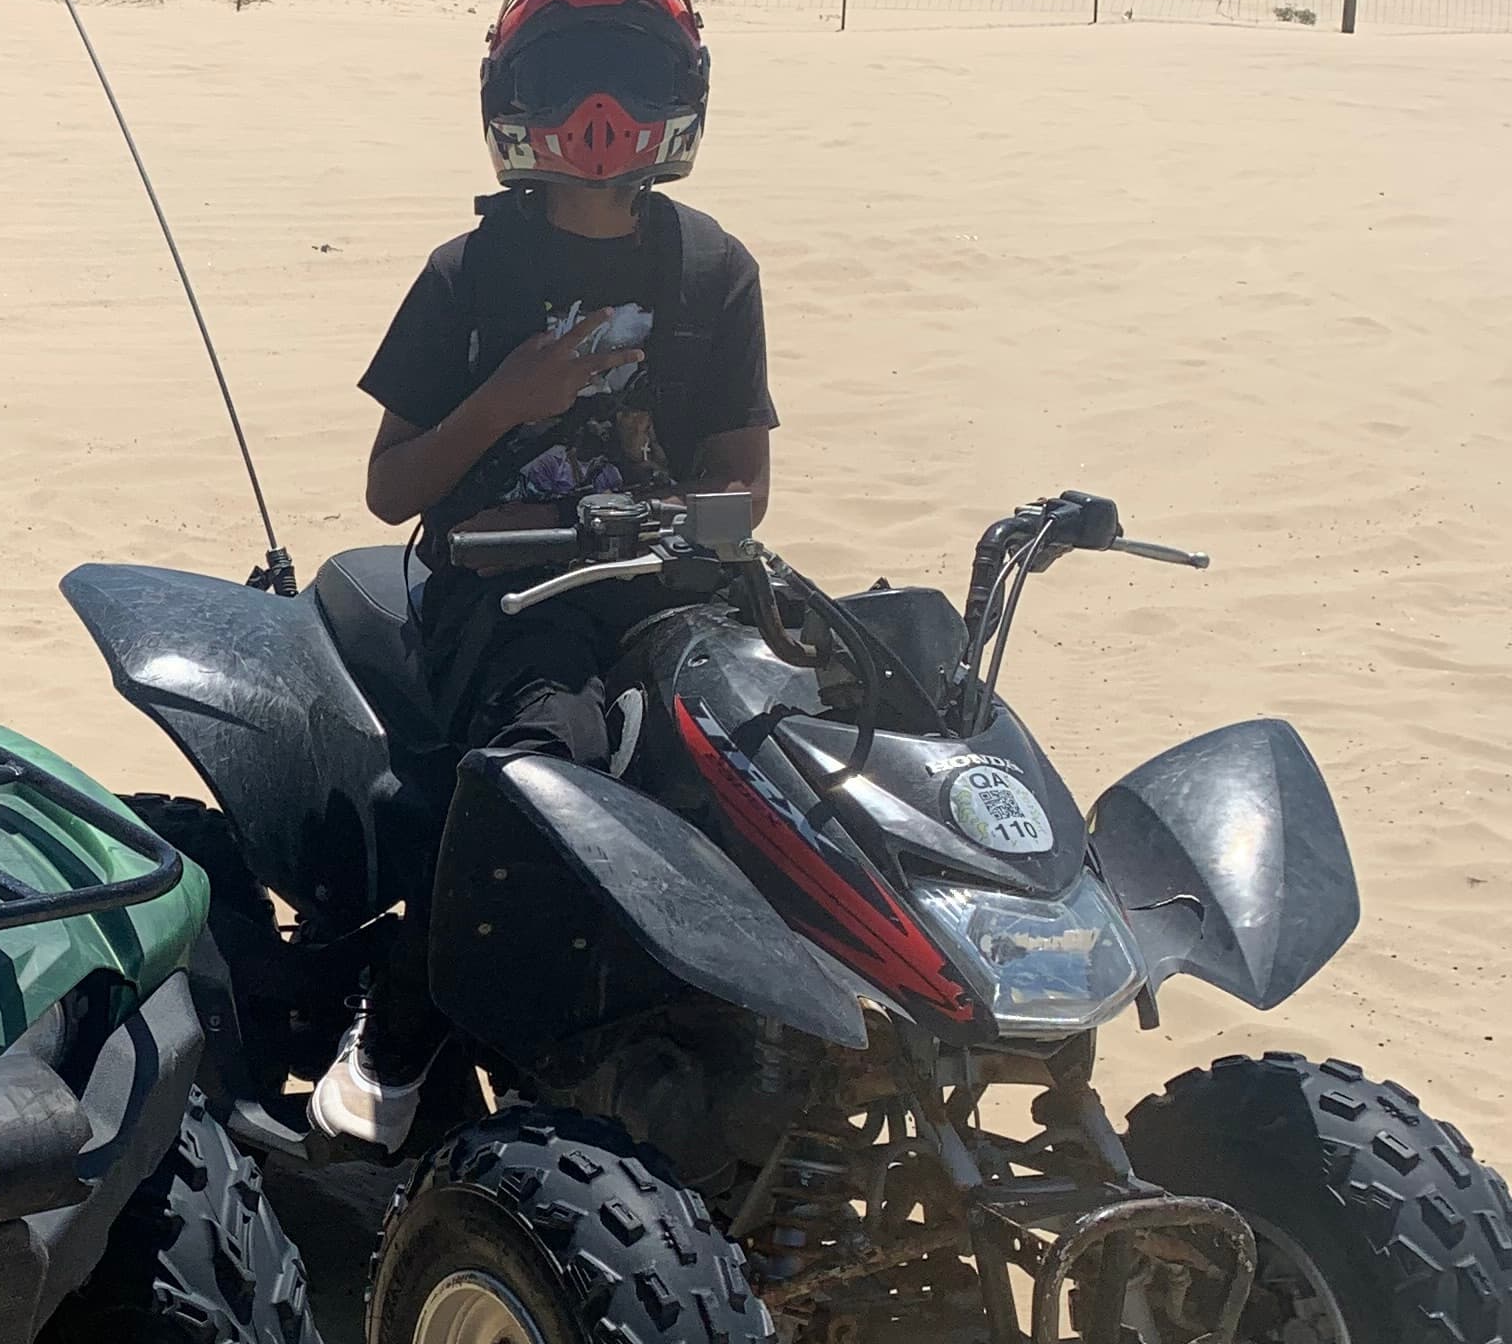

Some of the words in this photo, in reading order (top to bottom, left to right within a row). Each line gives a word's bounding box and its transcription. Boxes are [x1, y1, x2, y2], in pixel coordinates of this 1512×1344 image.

[925, 754, 1024, 776] HONDA
[969, 772, 1009, 789] QA
[995, 820, 1038, 841] 110
